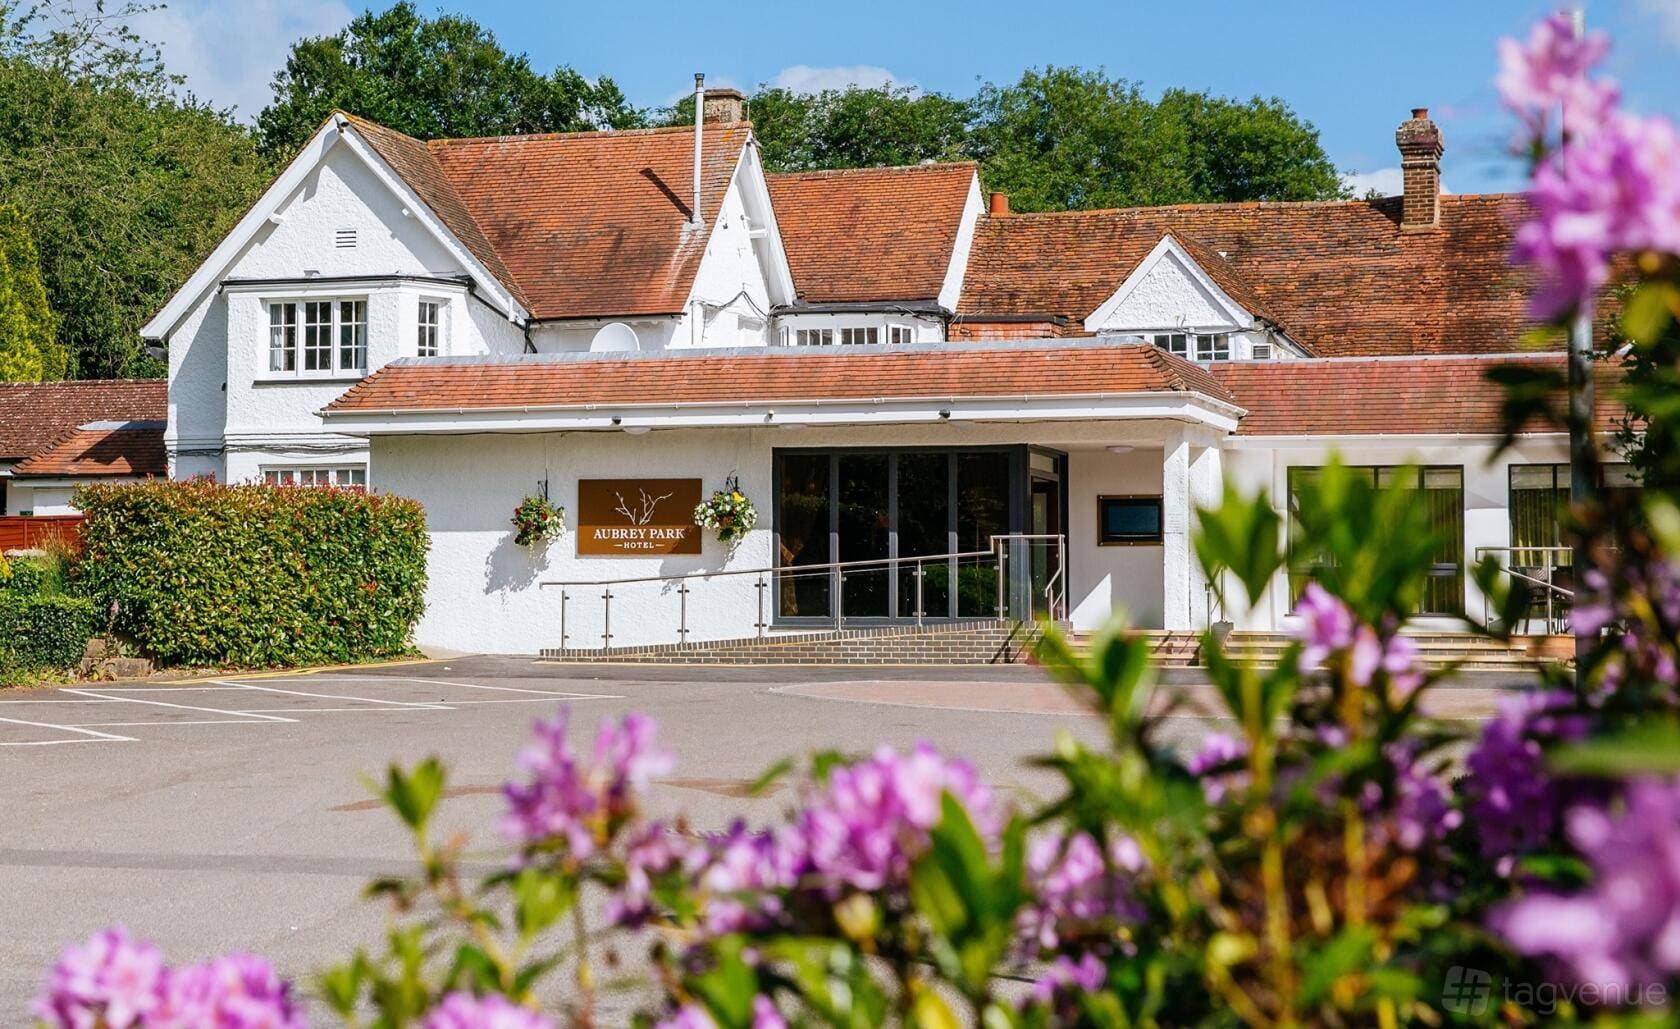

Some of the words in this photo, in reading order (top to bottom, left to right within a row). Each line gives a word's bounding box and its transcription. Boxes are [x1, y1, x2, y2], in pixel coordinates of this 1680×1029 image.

[593, 528, 646, 539] AUBREY
[649, 528, 685, 539] PARK
[623, 541, 655, 549] HOTEL
